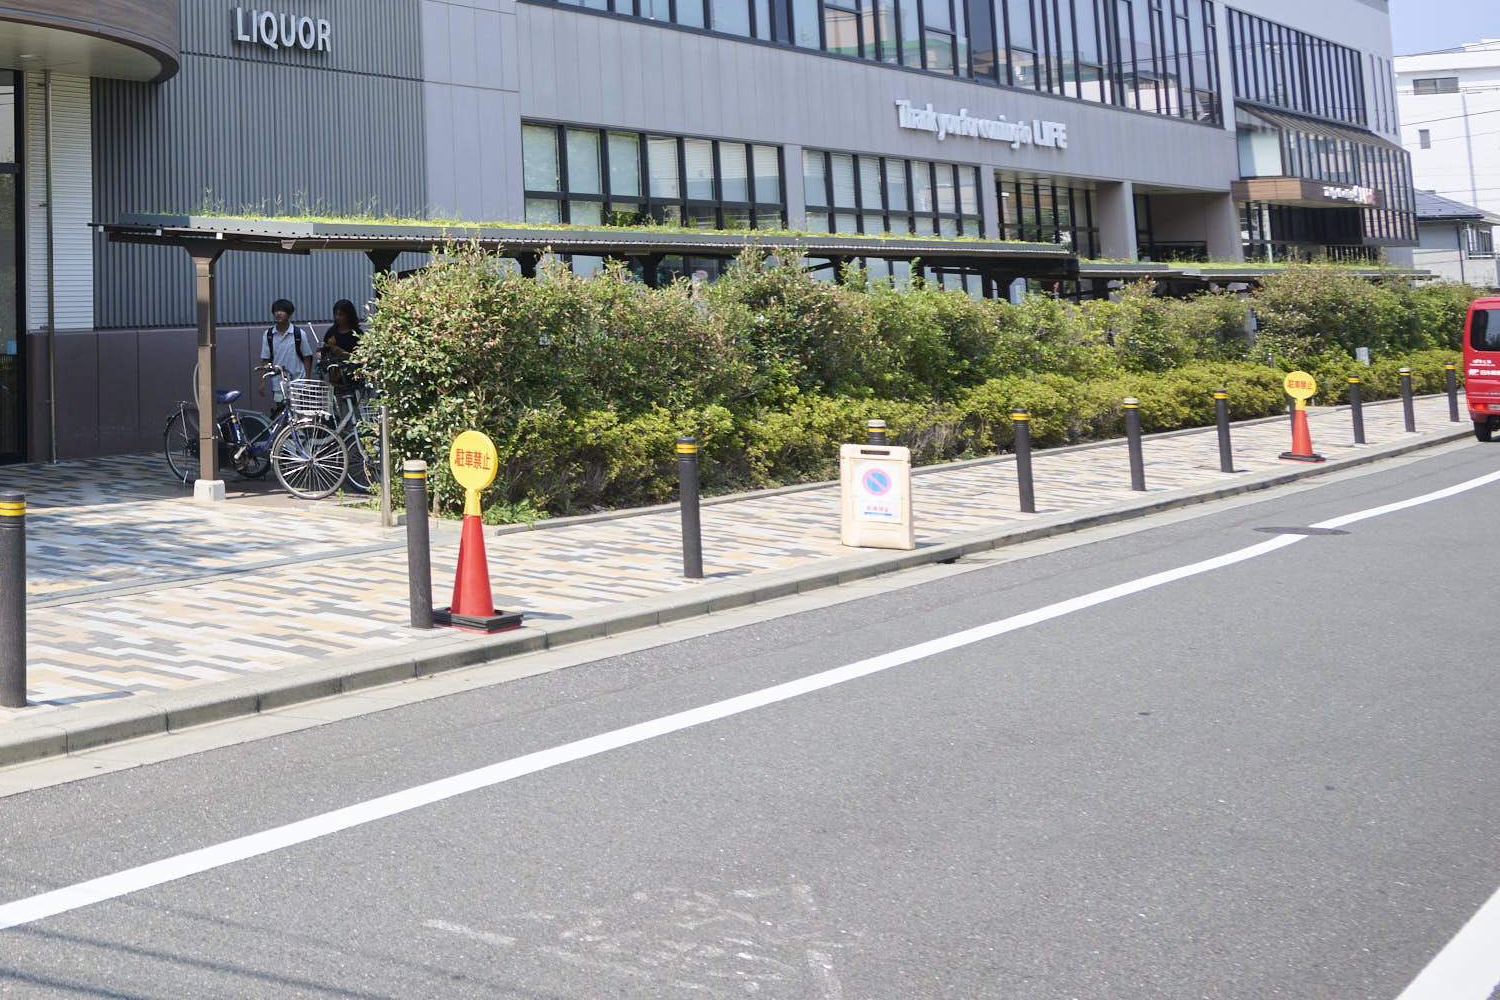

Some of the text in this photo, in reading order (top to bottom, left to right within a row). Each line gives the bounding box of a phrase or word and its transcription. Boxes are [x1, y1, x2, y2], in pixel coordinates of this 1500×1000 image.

[231, 7, 332, 53] LIQUOR
[1032, 119, 1068, 149] LIFE
[454, 448, 491, 470] 駐車禁止
